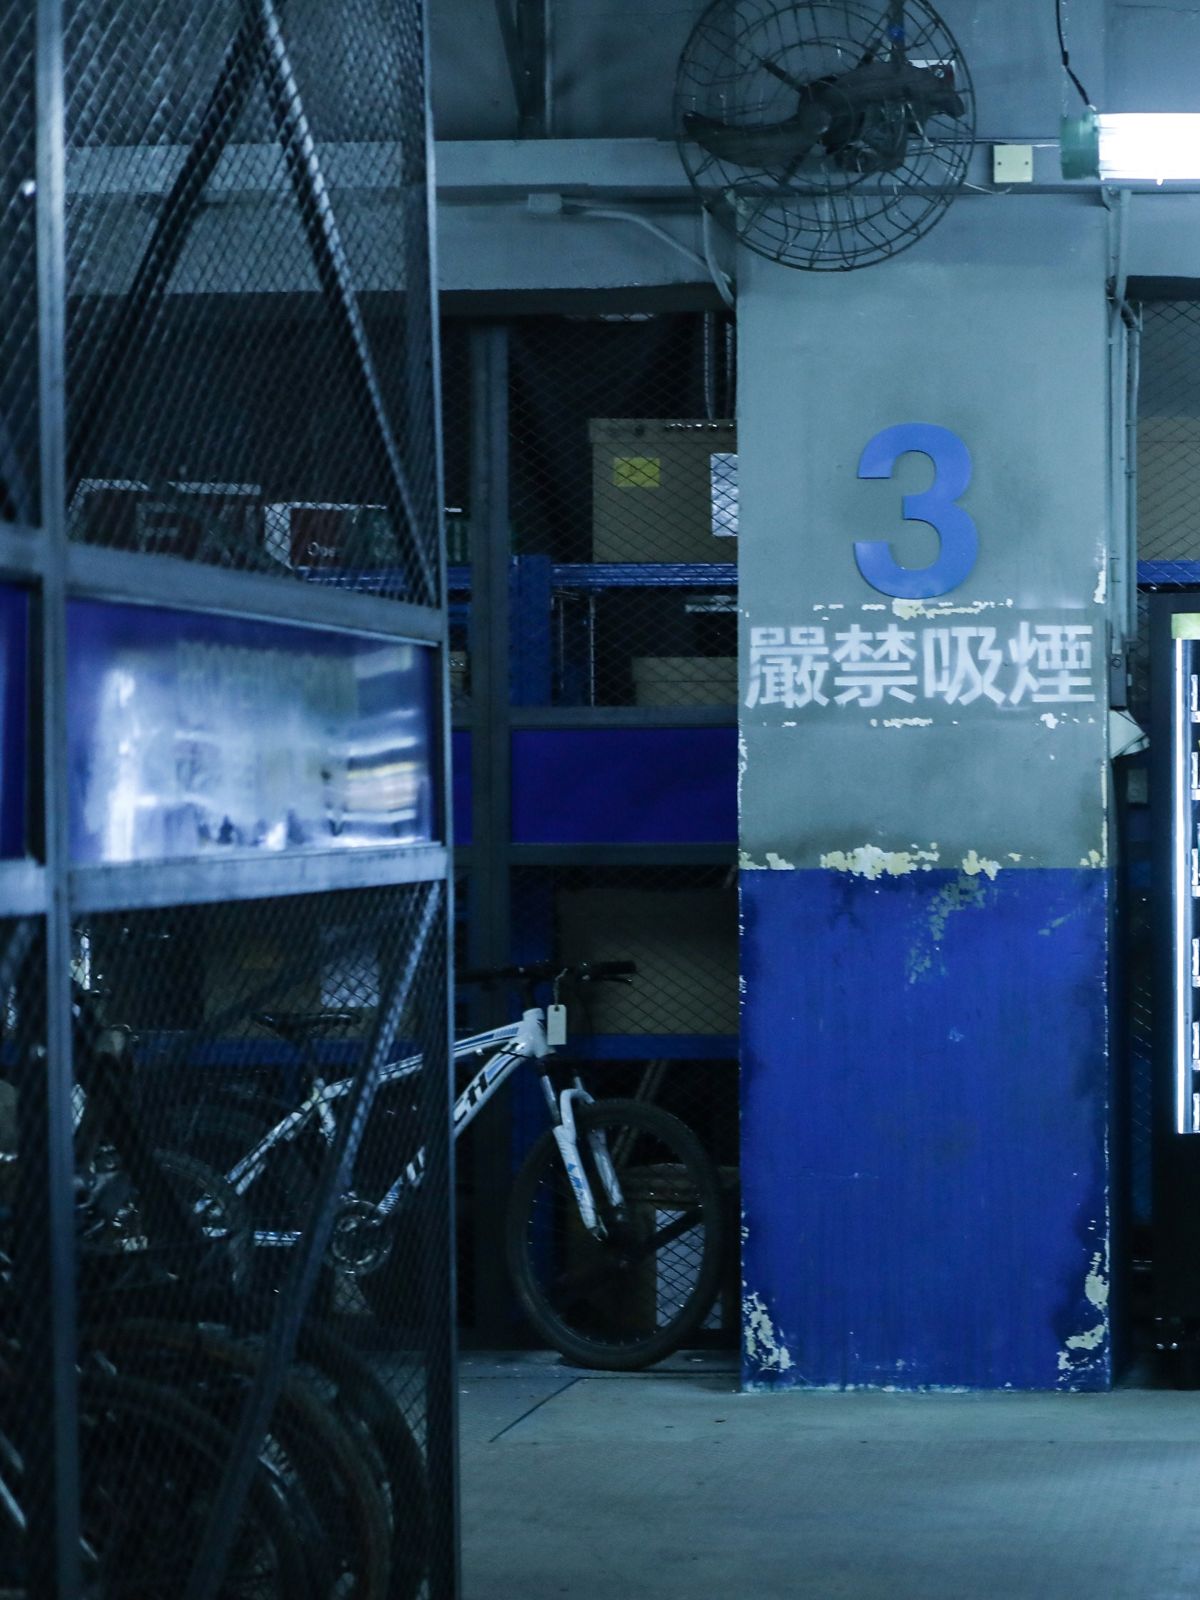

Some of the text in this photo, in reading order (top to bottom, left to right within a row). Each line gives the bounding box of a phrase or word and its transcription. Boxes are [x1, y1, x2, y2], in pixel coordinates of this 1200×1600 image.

[854, 422, 979, 599] 3
[744, 621, 1096, 710] 嚴禁吸煙
